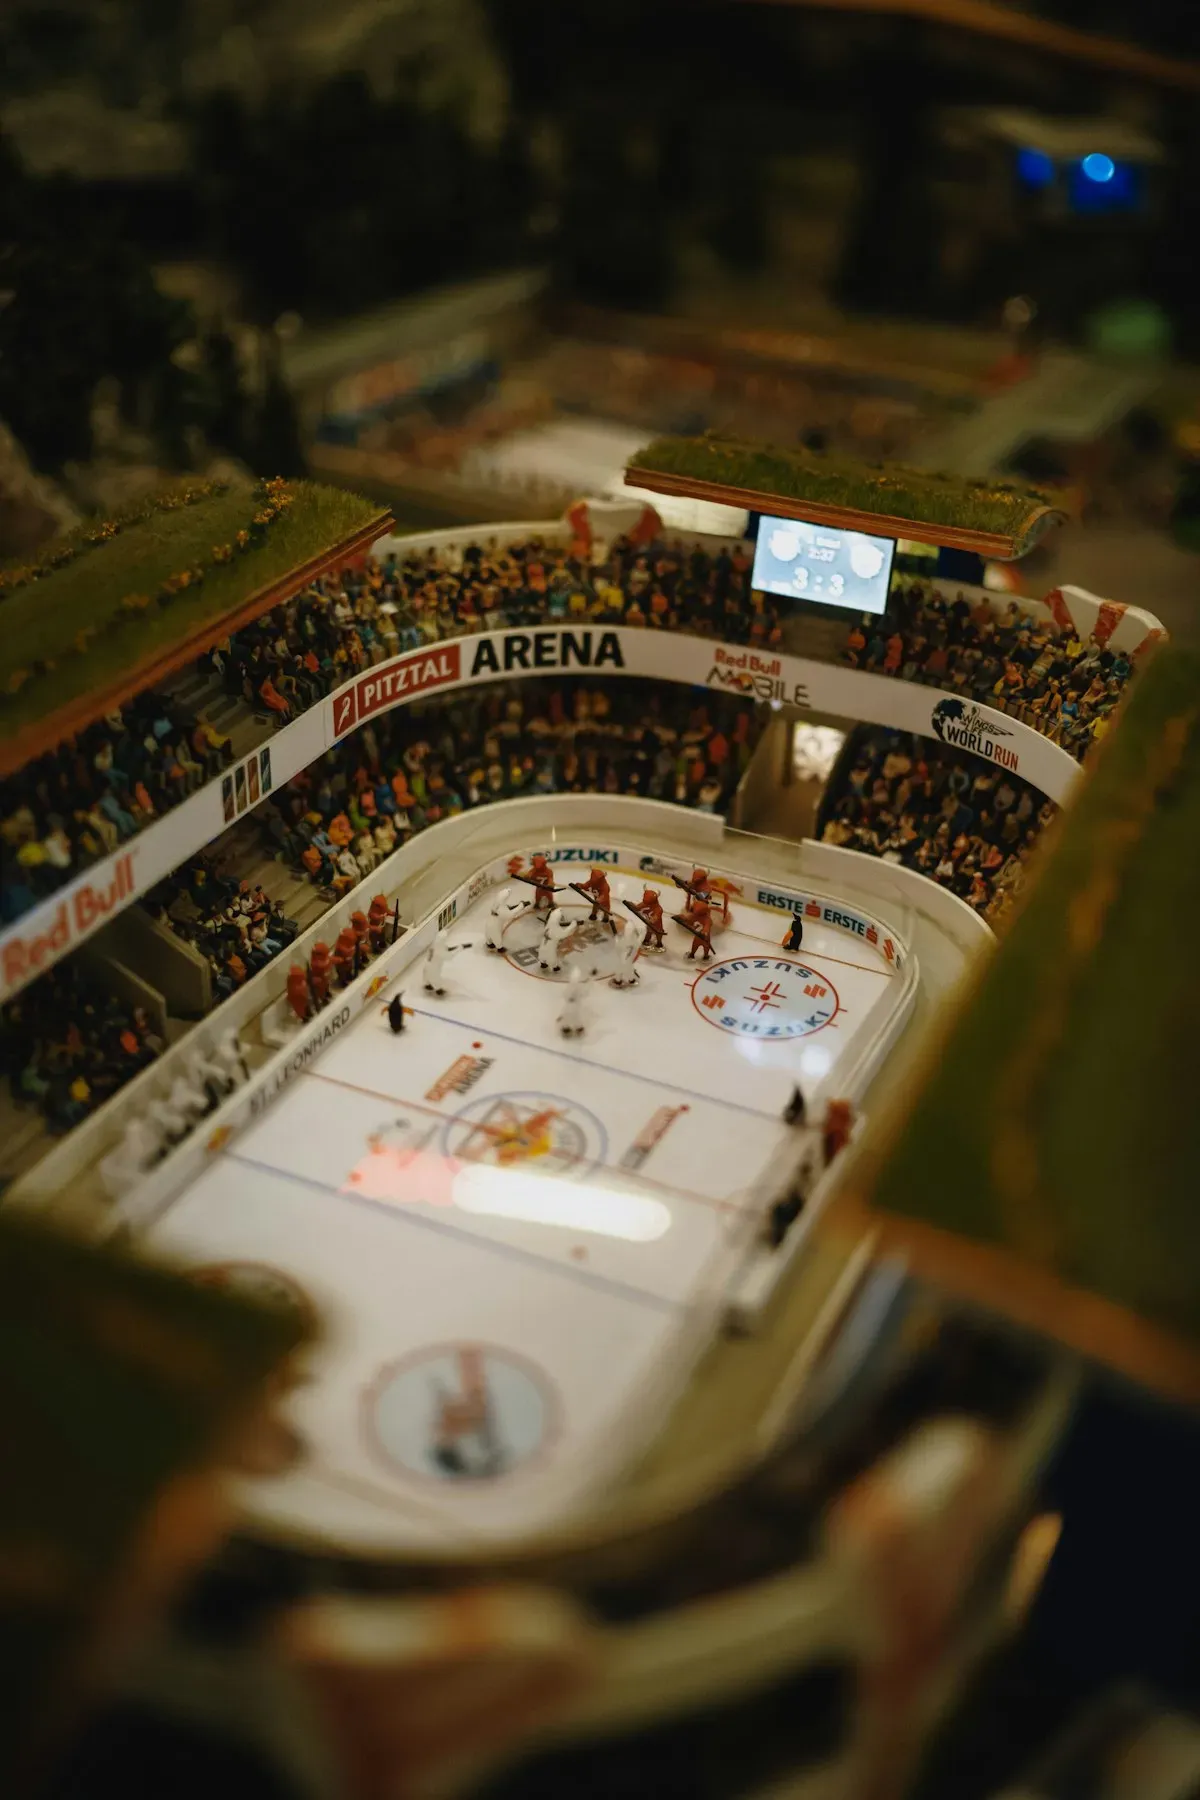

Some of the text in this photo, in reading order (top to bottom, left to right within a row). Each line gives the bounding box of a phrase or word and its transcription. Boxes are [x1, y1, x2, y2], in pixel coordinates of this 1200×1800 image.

[793, 567, 809, 590] 3
[828, 574, 844, 597] 3
[363, 632, 625, 708] PITZTAL ARENA
[714, 647, 782, 677] Red Bull
[961, 714, 995, 733] WINGS
[947, 724, 1019, 771] WORLD RUN
[757, 891, 803, 913] ERSTE
[2, 853, 134, 985] Red Bull
[824, 908, 865, 937] ERSTE
[706, 960, 812, 983] SUZUKI
[720, 1011, 830, 1036] SUZUKI
